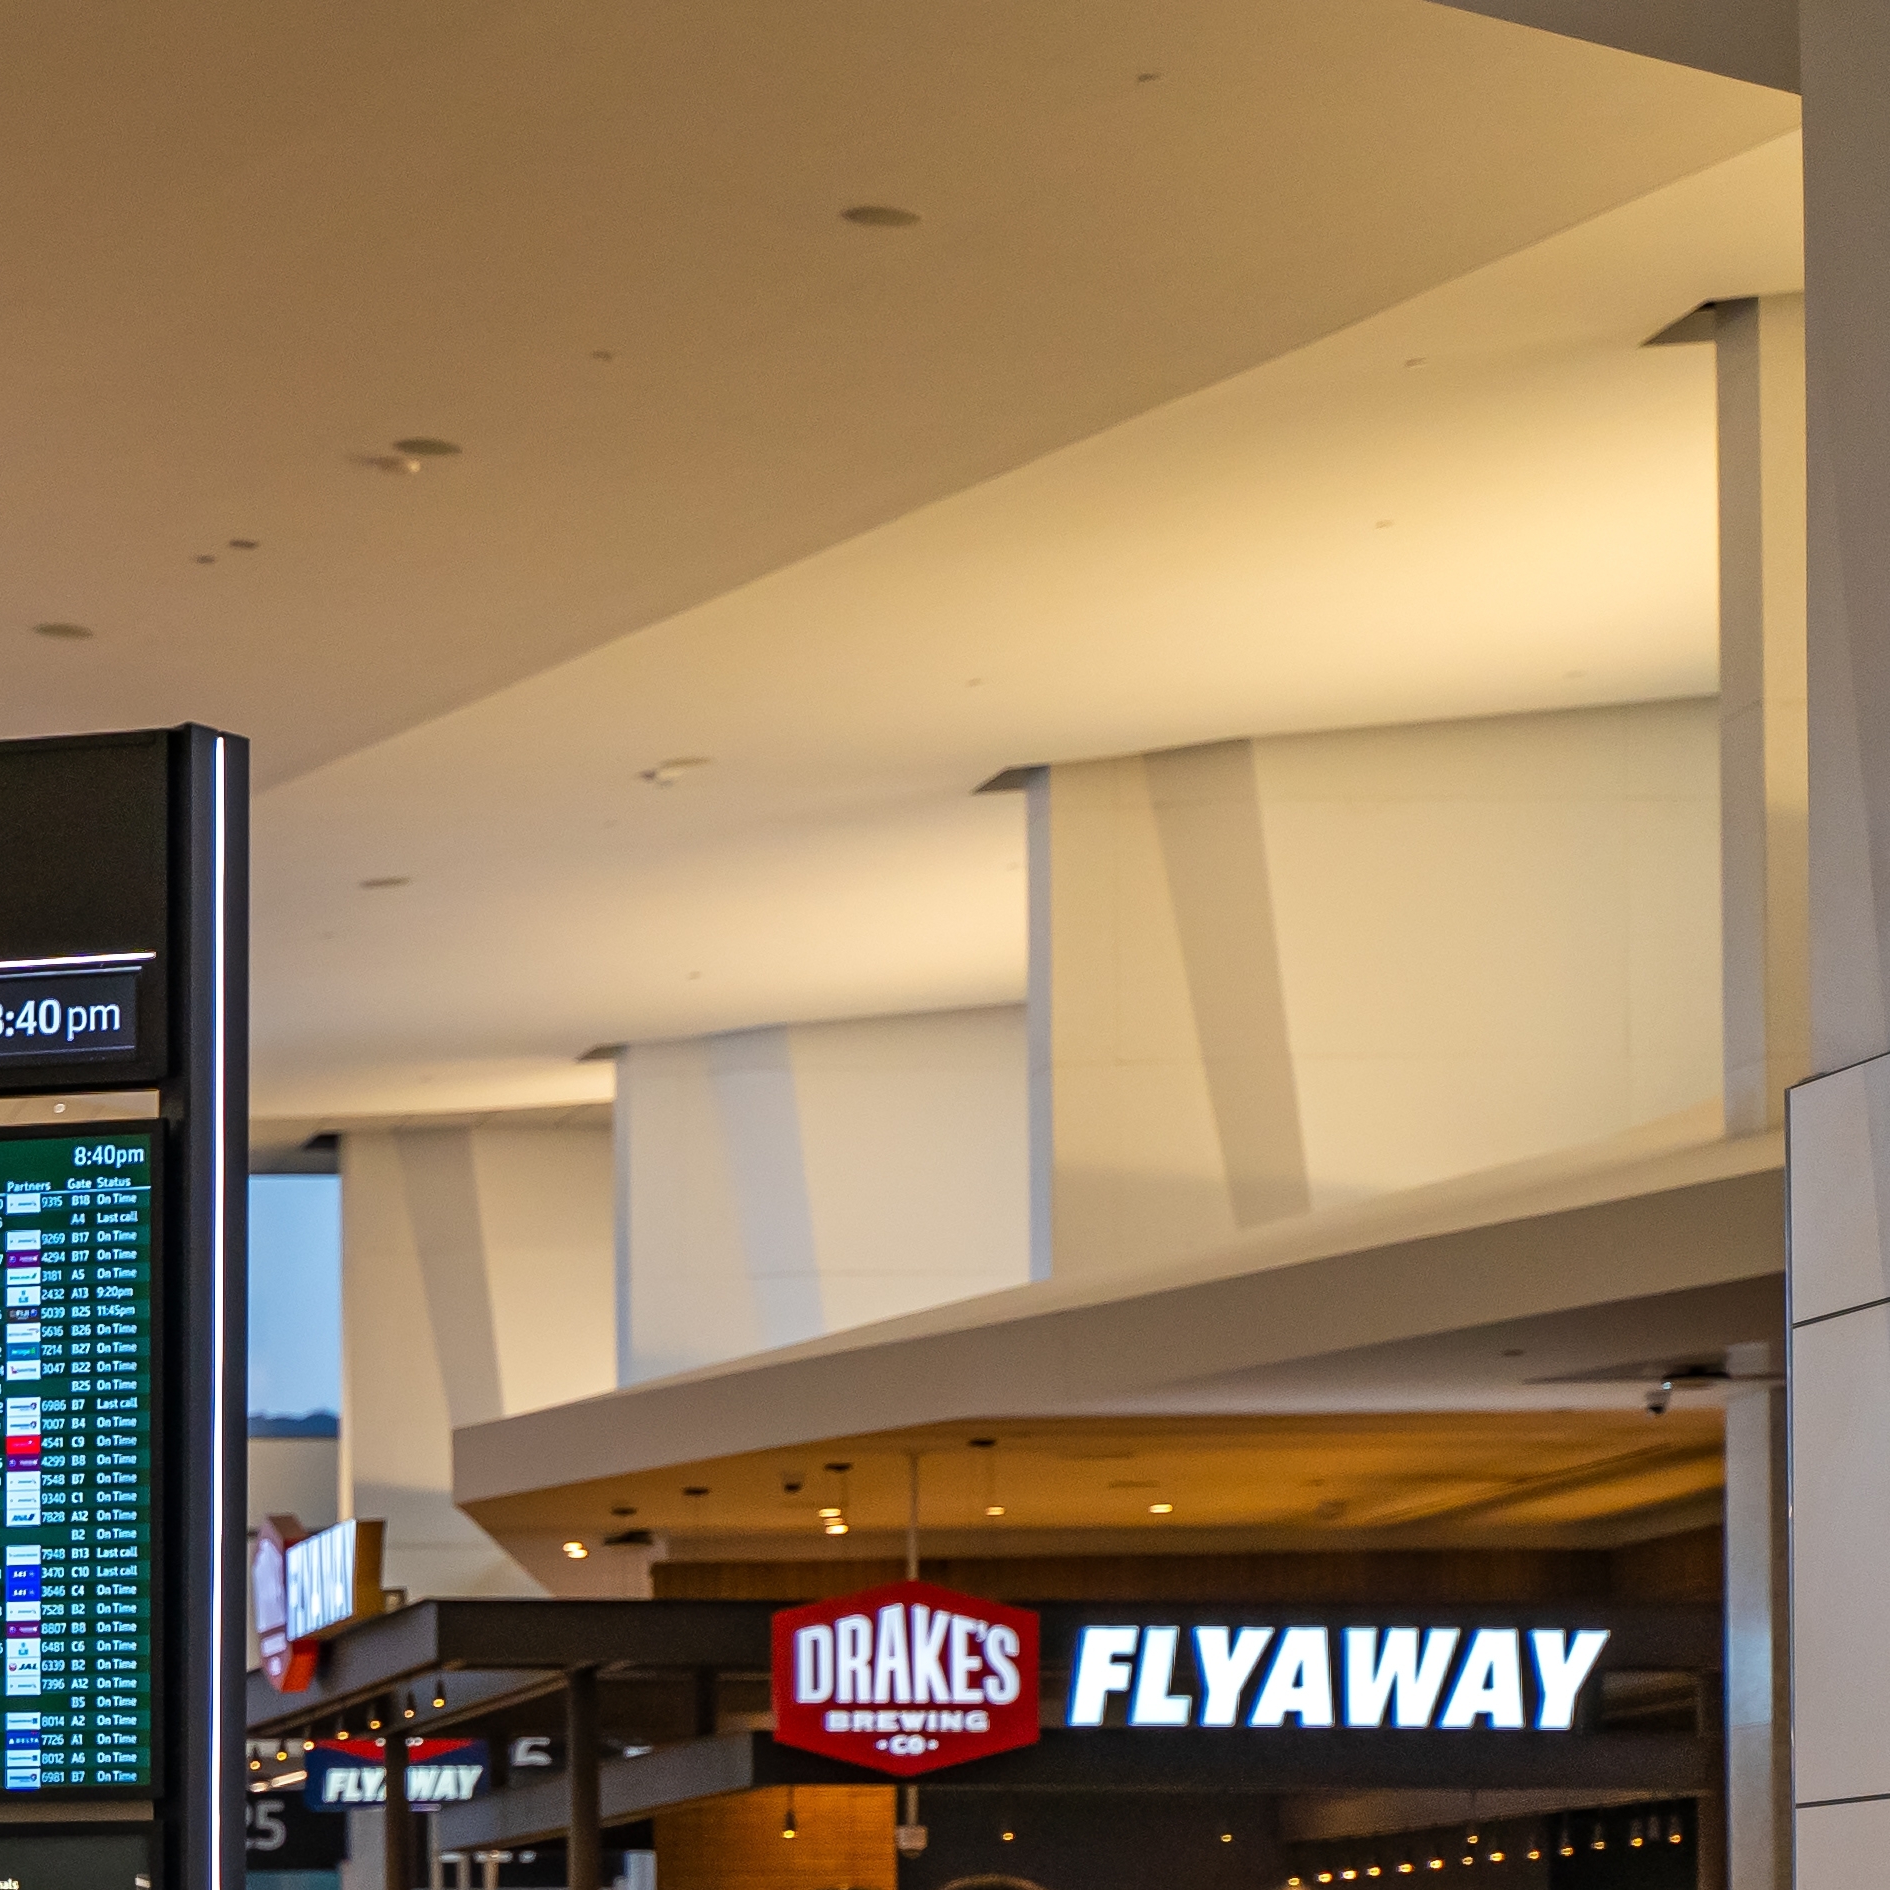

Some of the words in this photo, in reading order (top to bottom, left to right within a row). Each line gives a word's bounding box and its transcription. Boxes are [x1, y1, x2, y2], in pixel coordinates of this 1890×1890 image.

[75, 1145, 144, 1168] 8:40pm
[7, 1181, 51, 1192] Partners
[68, 1179, 92, 1189] Gate
[97, 1177, 131, 1188] Status
[793, 1602, 1021, 1705] DRAKE'S
[1072, 1626, 1610, 1730] FLYAWAY
[824, 1709, 990, 1732] BREWING
[322, 1765, 483, 1803] FLYWAY
